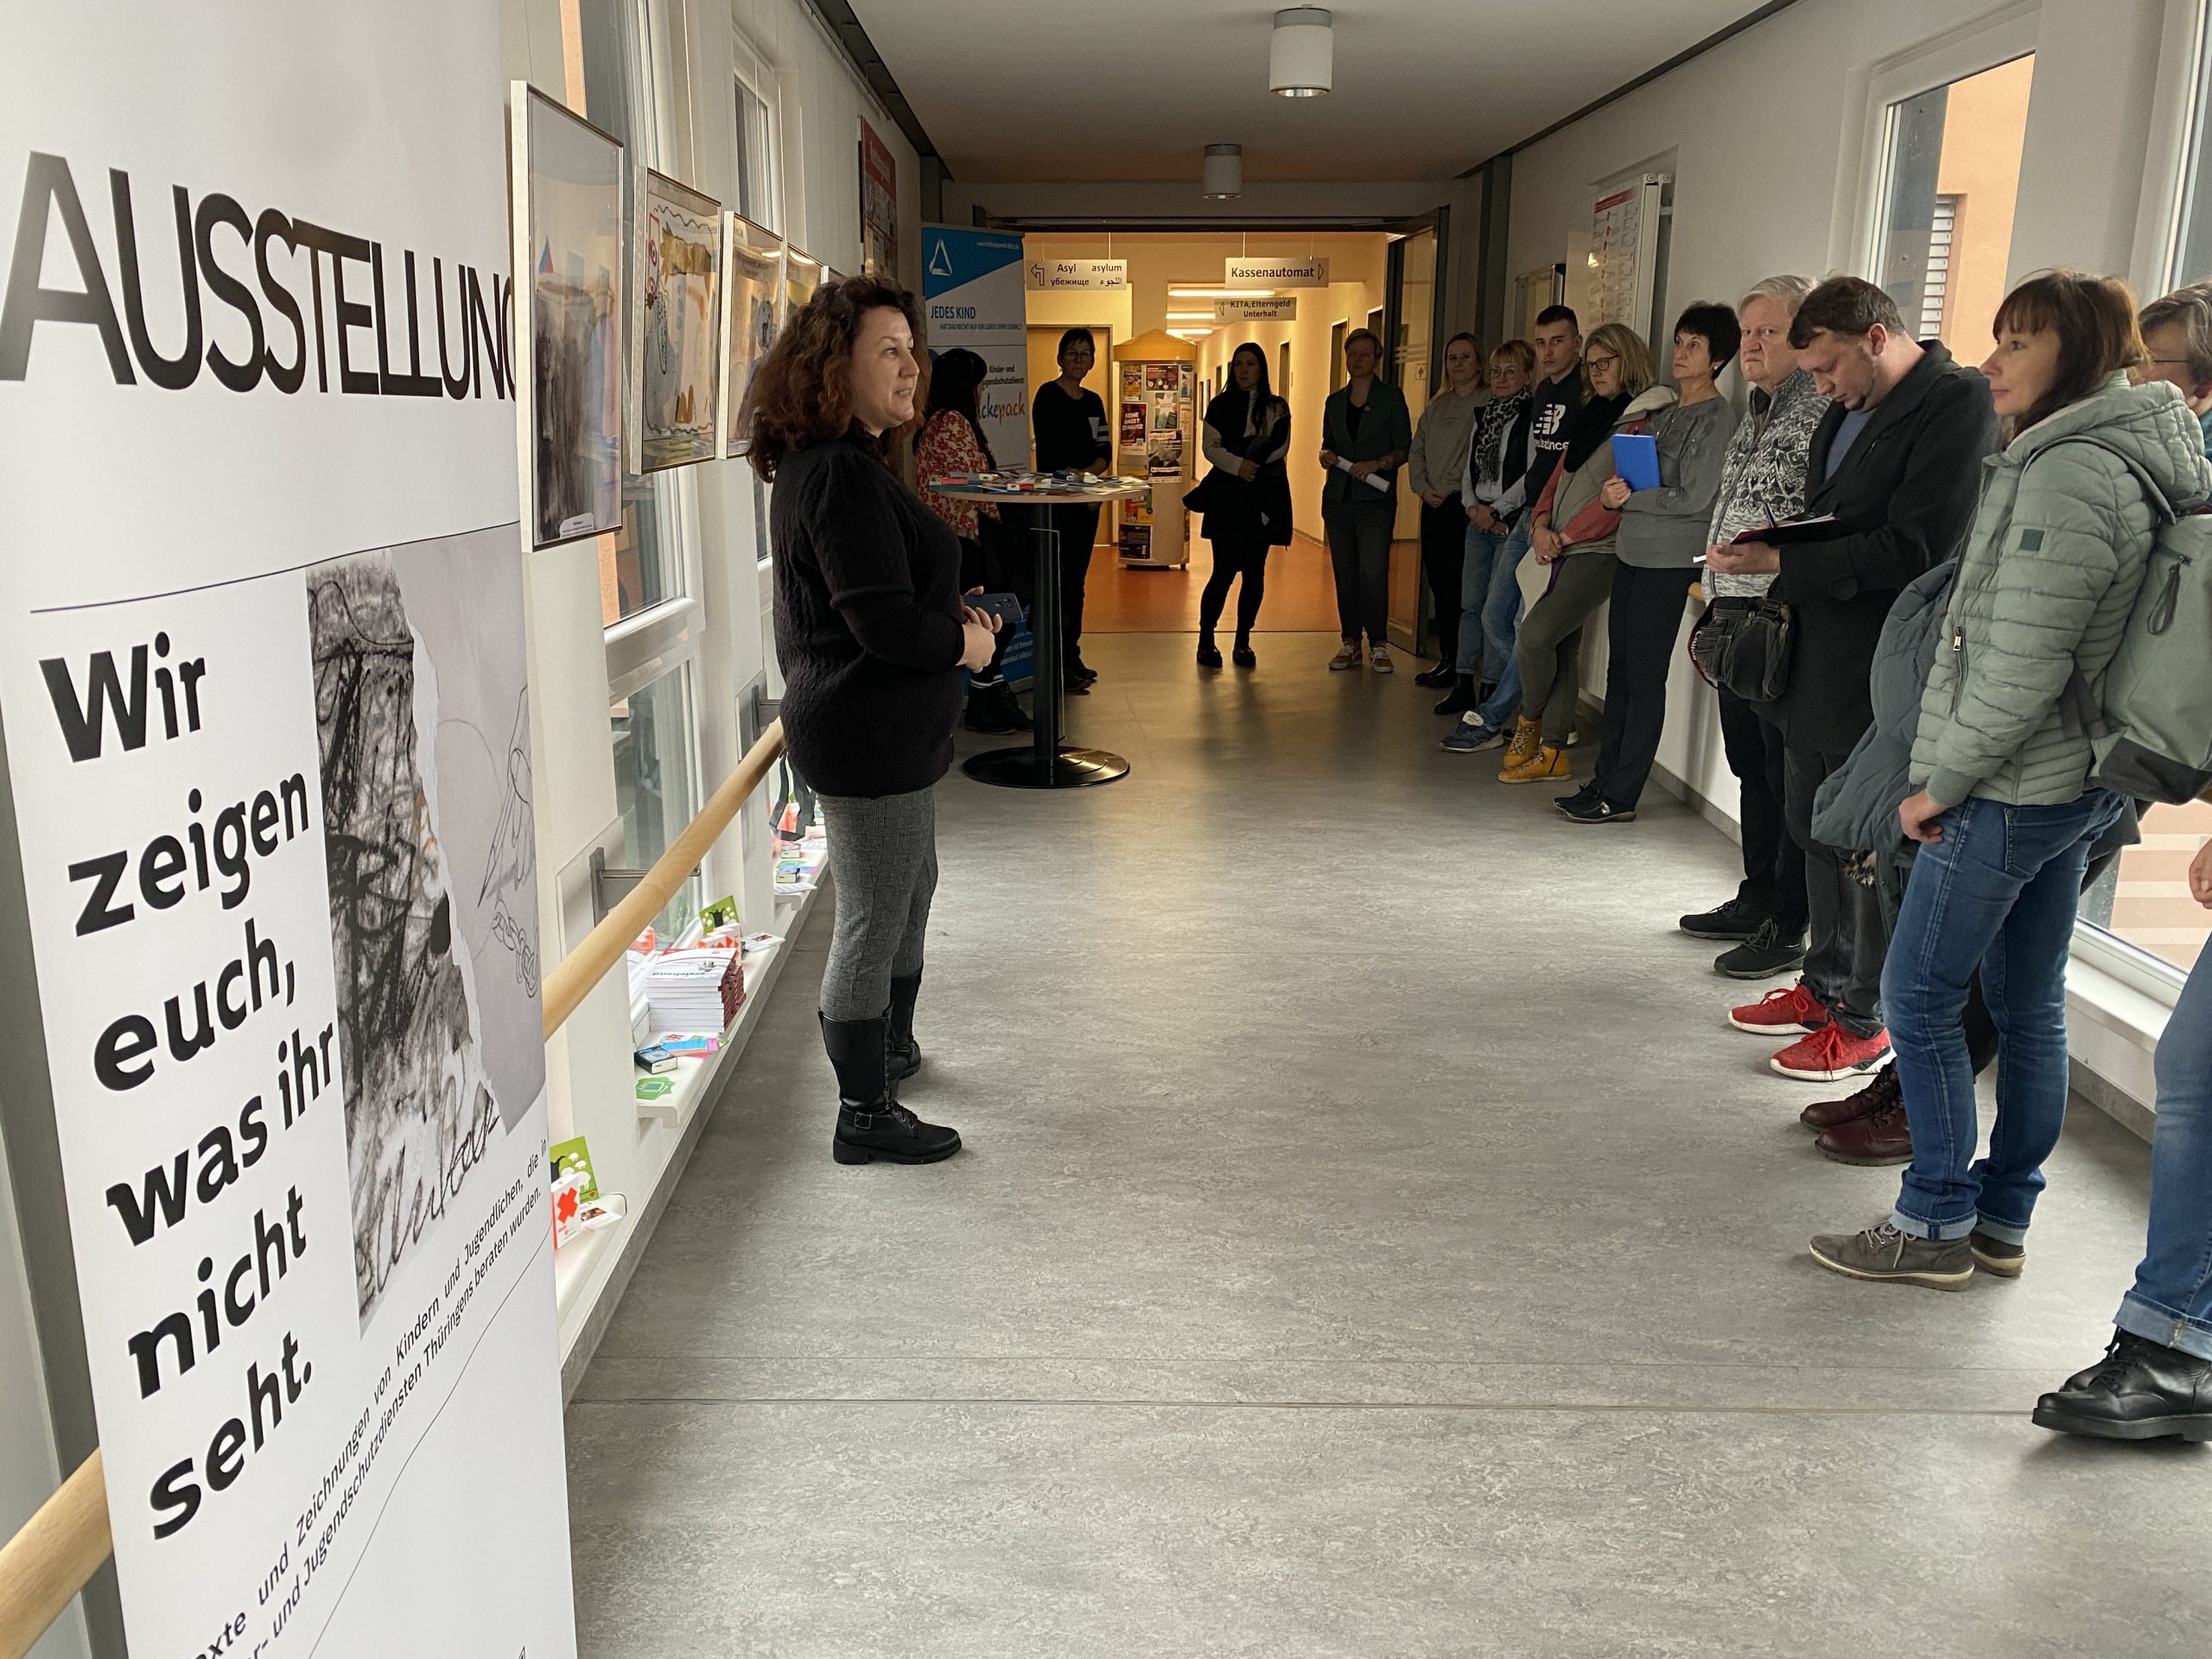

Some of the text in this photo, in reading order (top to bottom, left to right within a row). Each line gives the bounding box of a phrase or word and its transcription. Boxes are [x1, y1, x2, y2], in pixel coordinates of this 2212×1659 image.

[931, 306, 976, 320] JEDES KIND
[1051, 277, 1090, 287] убежище
[1057, 264, 1122, 274] Asyl asylum
[1100, 277, 1122, 287] اللجوء
[1231, 267, 1314, 277] Kassenautomat
[977, 391, 1026, 426] ckepack
[1005, 364, 1015, 373] und
[38, 631, 207, 764] Wir
[67, 772, 310, 938] zeigen
[93, 918, 296, 1091] euch,
[105, 1095, 268, 1247] was
[277, 1022, 334, 1130] ihr
[127, 1184, 308, 1400] nicht
[149, 1330, 313, 1541] seht.
[257, 1541, 289, 1606] und
[296, 1407, 371, 1548] Zeichnungen
[373, 1365, 391, 1406] von
[396, 1297, 440, 1366] Kindern
[444, 1257, 461, 1299] und
[464, 1179, 524, 1266] Jugendlichen,
[527, 1154, 538, 1179] die
[272, 1574, 301, 1639] und
[303, 1363, 423, 1586] Jugendschutzdiensten
[423, 1280, 474, 1368] Thüringens
[474, 1230, 508, 1289] beraten
[509, 1186, 541, 1237] wurden.
